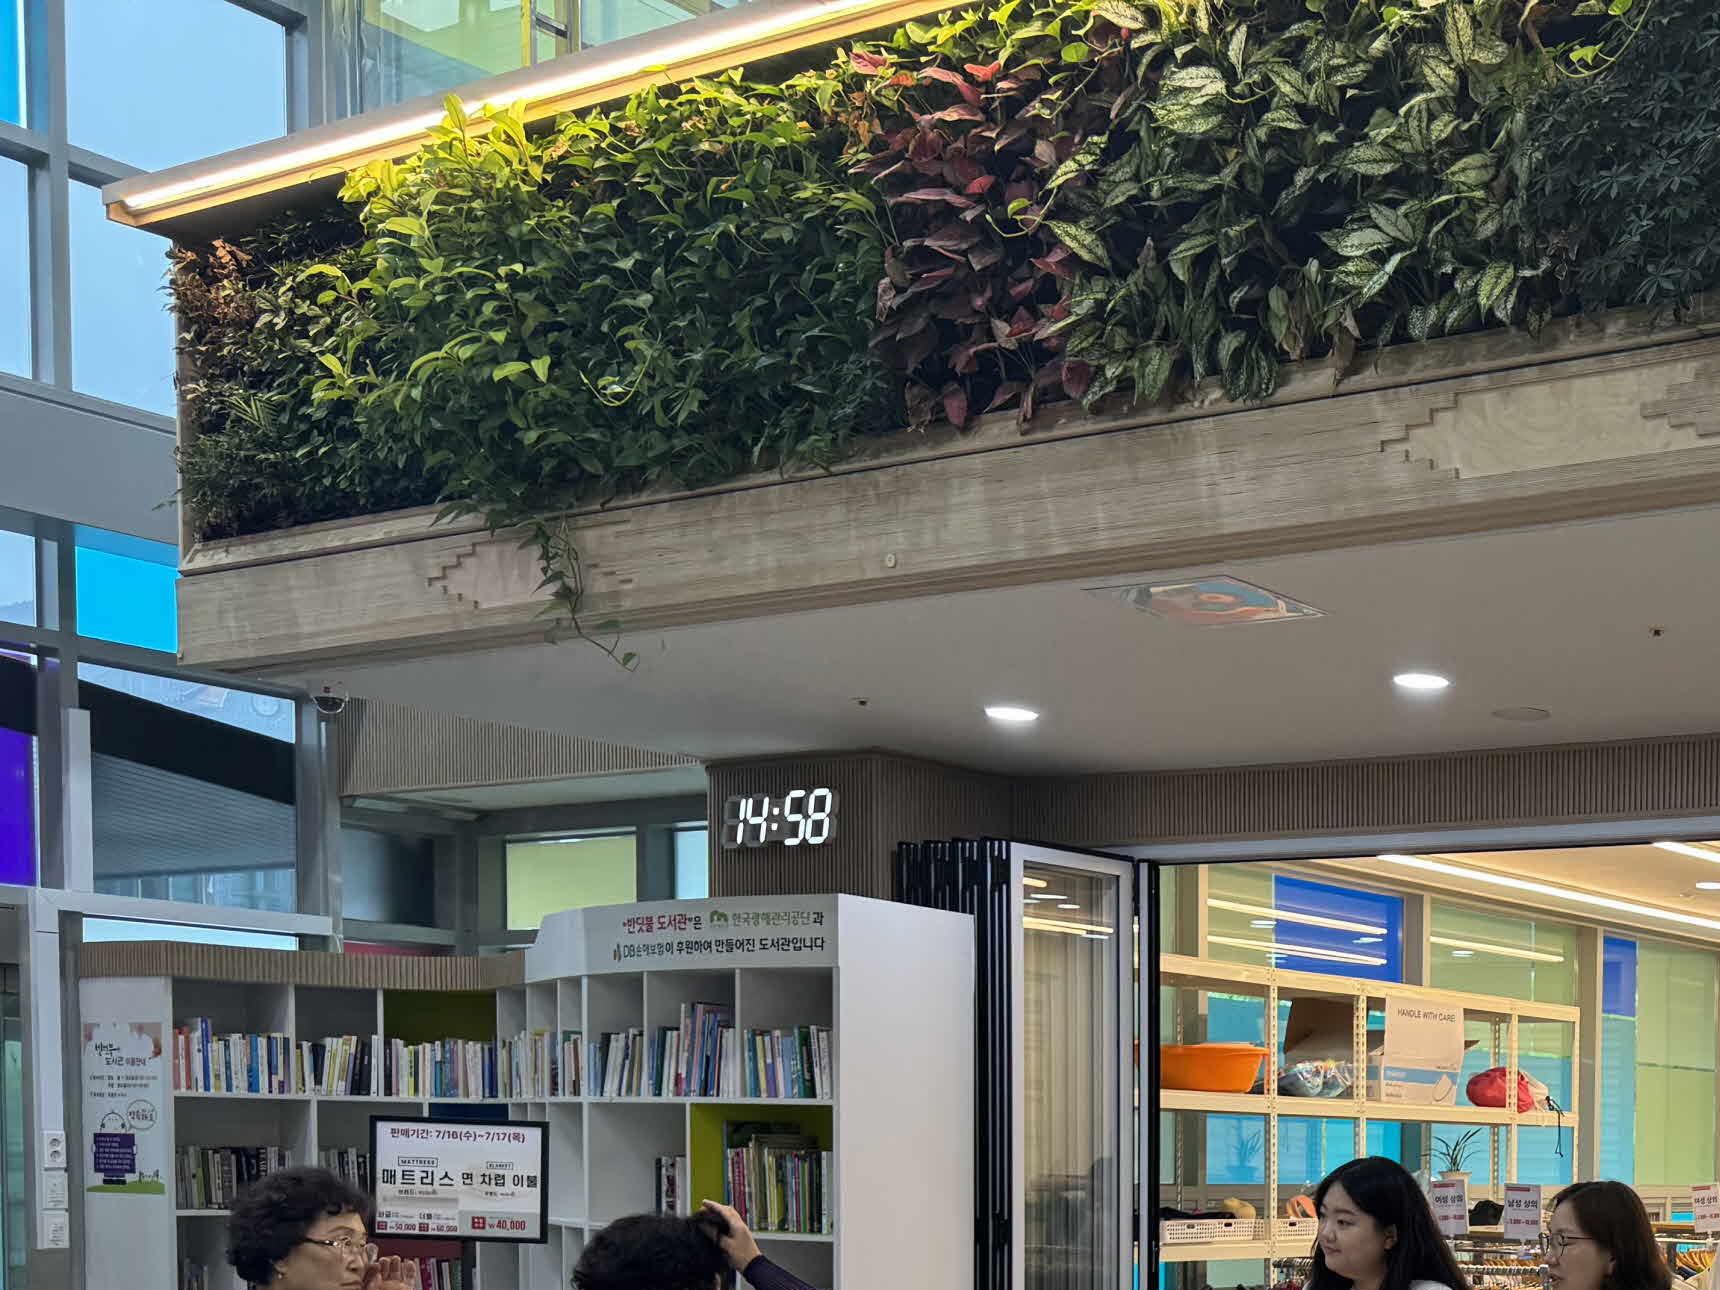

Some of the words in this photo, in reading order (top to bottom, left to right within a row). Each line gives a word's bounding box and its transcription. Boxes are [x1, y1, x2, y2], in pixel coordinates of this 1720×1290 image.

[736, 788, 832, 846] 14:58
[714, 938, 755, 953] 만들어진
[759, 936, 825, 952] 도서관입니다
[1397, 1008, 1422, 1019] HANDLE
[1422, 1011, 1438, 1020] WITH
[390, 1127, 433, 1139] 판매기간:
[382, 1168, 455, 1187] 매트리스
[461, 1172, 474, 1186] 면
[480, 1172, 506, 1187] 차렵
